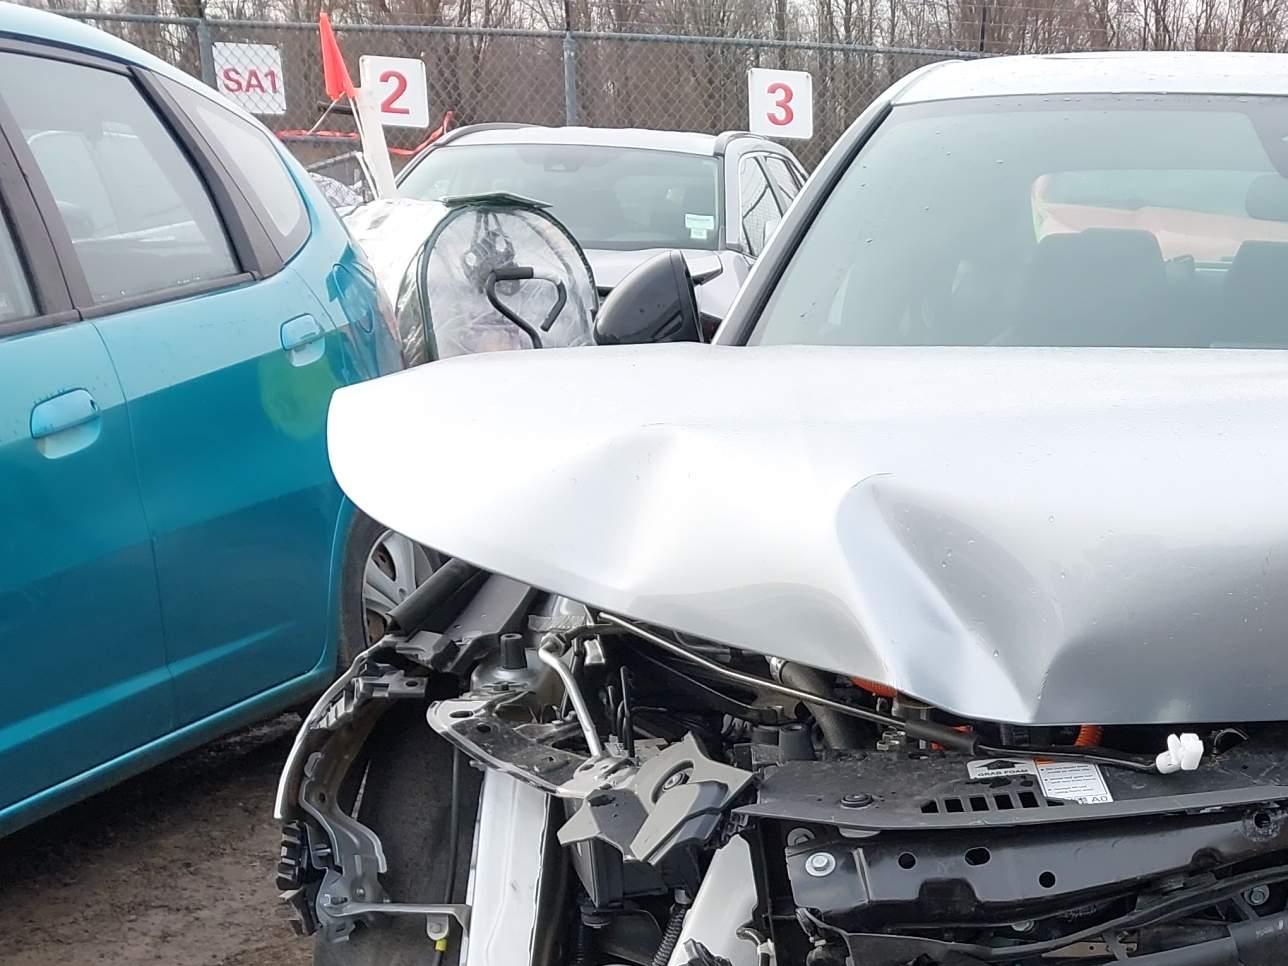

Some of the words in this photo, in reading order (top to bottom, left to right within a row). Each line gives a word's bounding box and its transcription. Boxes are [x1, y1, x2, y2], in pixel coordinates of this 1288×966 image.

[223, 68, 277, 94] SA1
[379, 70, 410, 115] 2
[766, 82, 794, 126] 3
